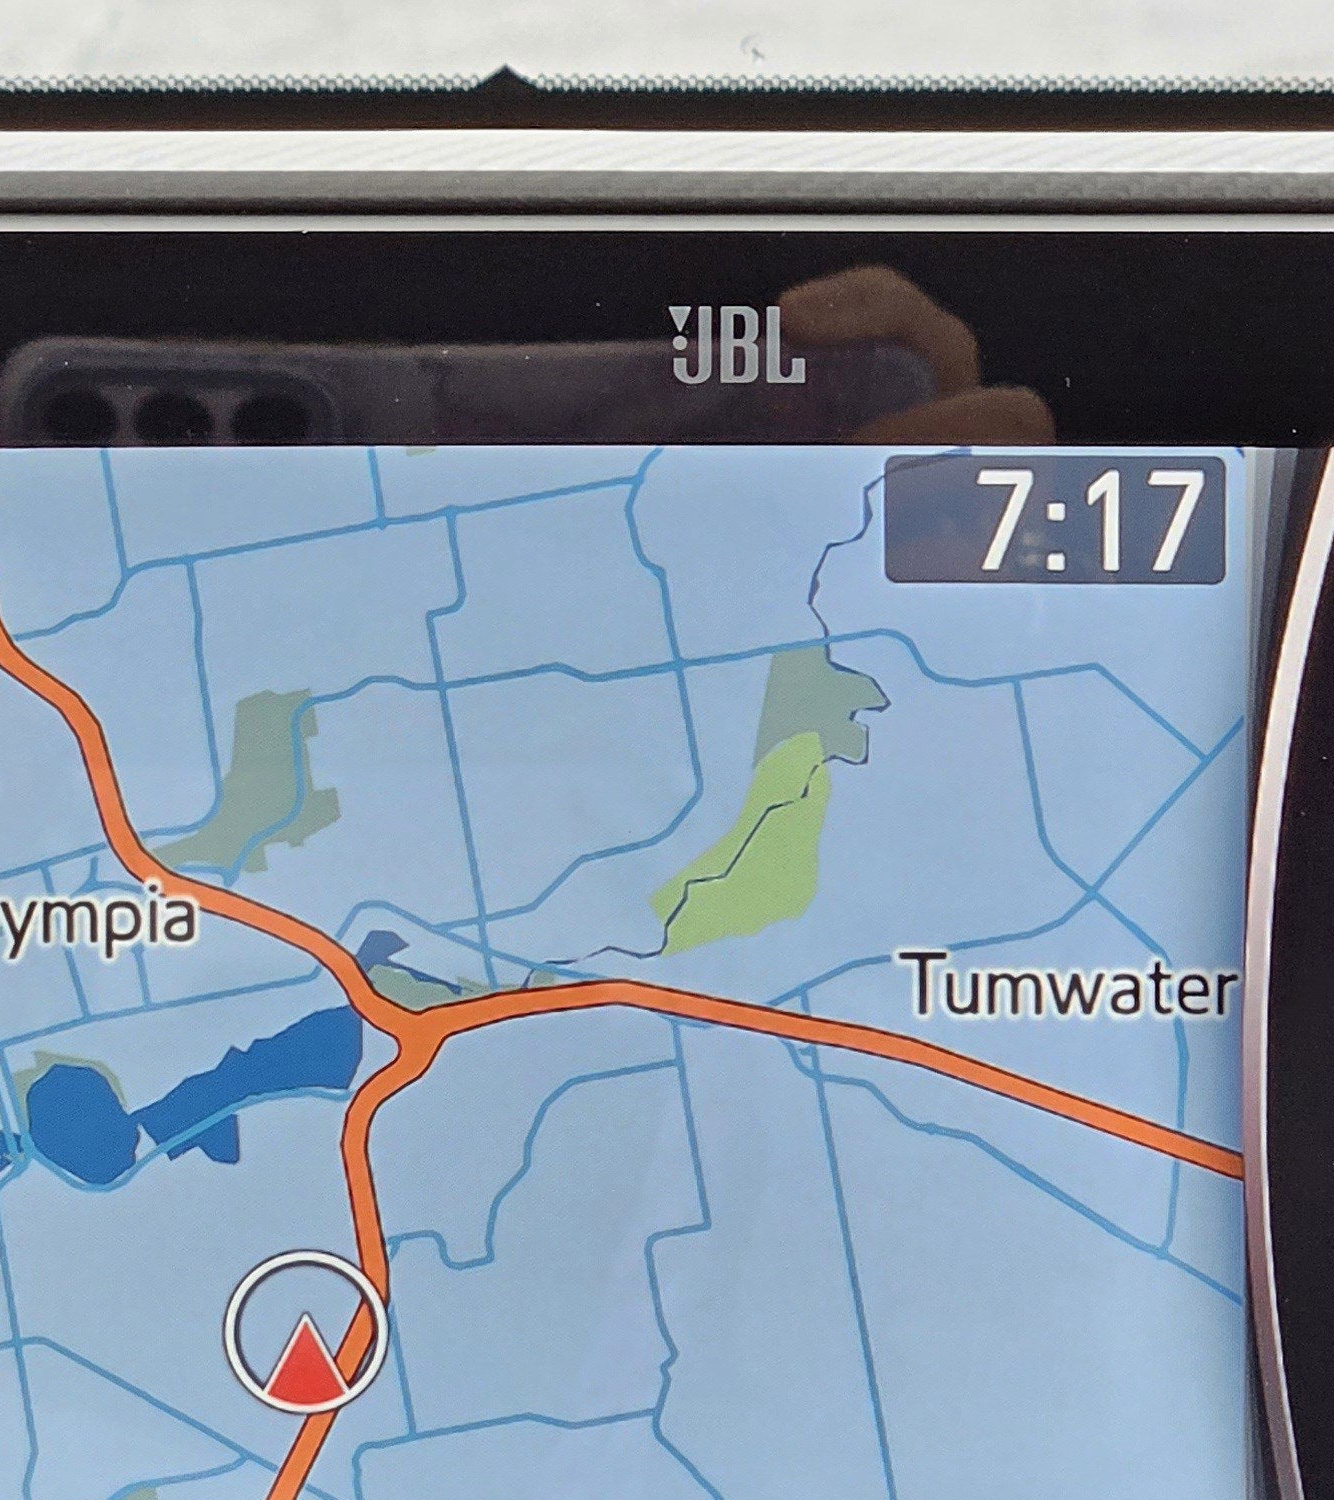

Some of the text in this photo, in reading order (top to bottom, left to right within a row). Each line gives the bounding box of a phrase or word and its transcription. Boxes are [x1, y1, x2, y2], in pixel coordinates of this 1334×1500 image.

[669, 305, 806, 384] JBL
[977, 470, 1205, 572] 7:17
[899, 952, 1239, 1016] Tumwater
